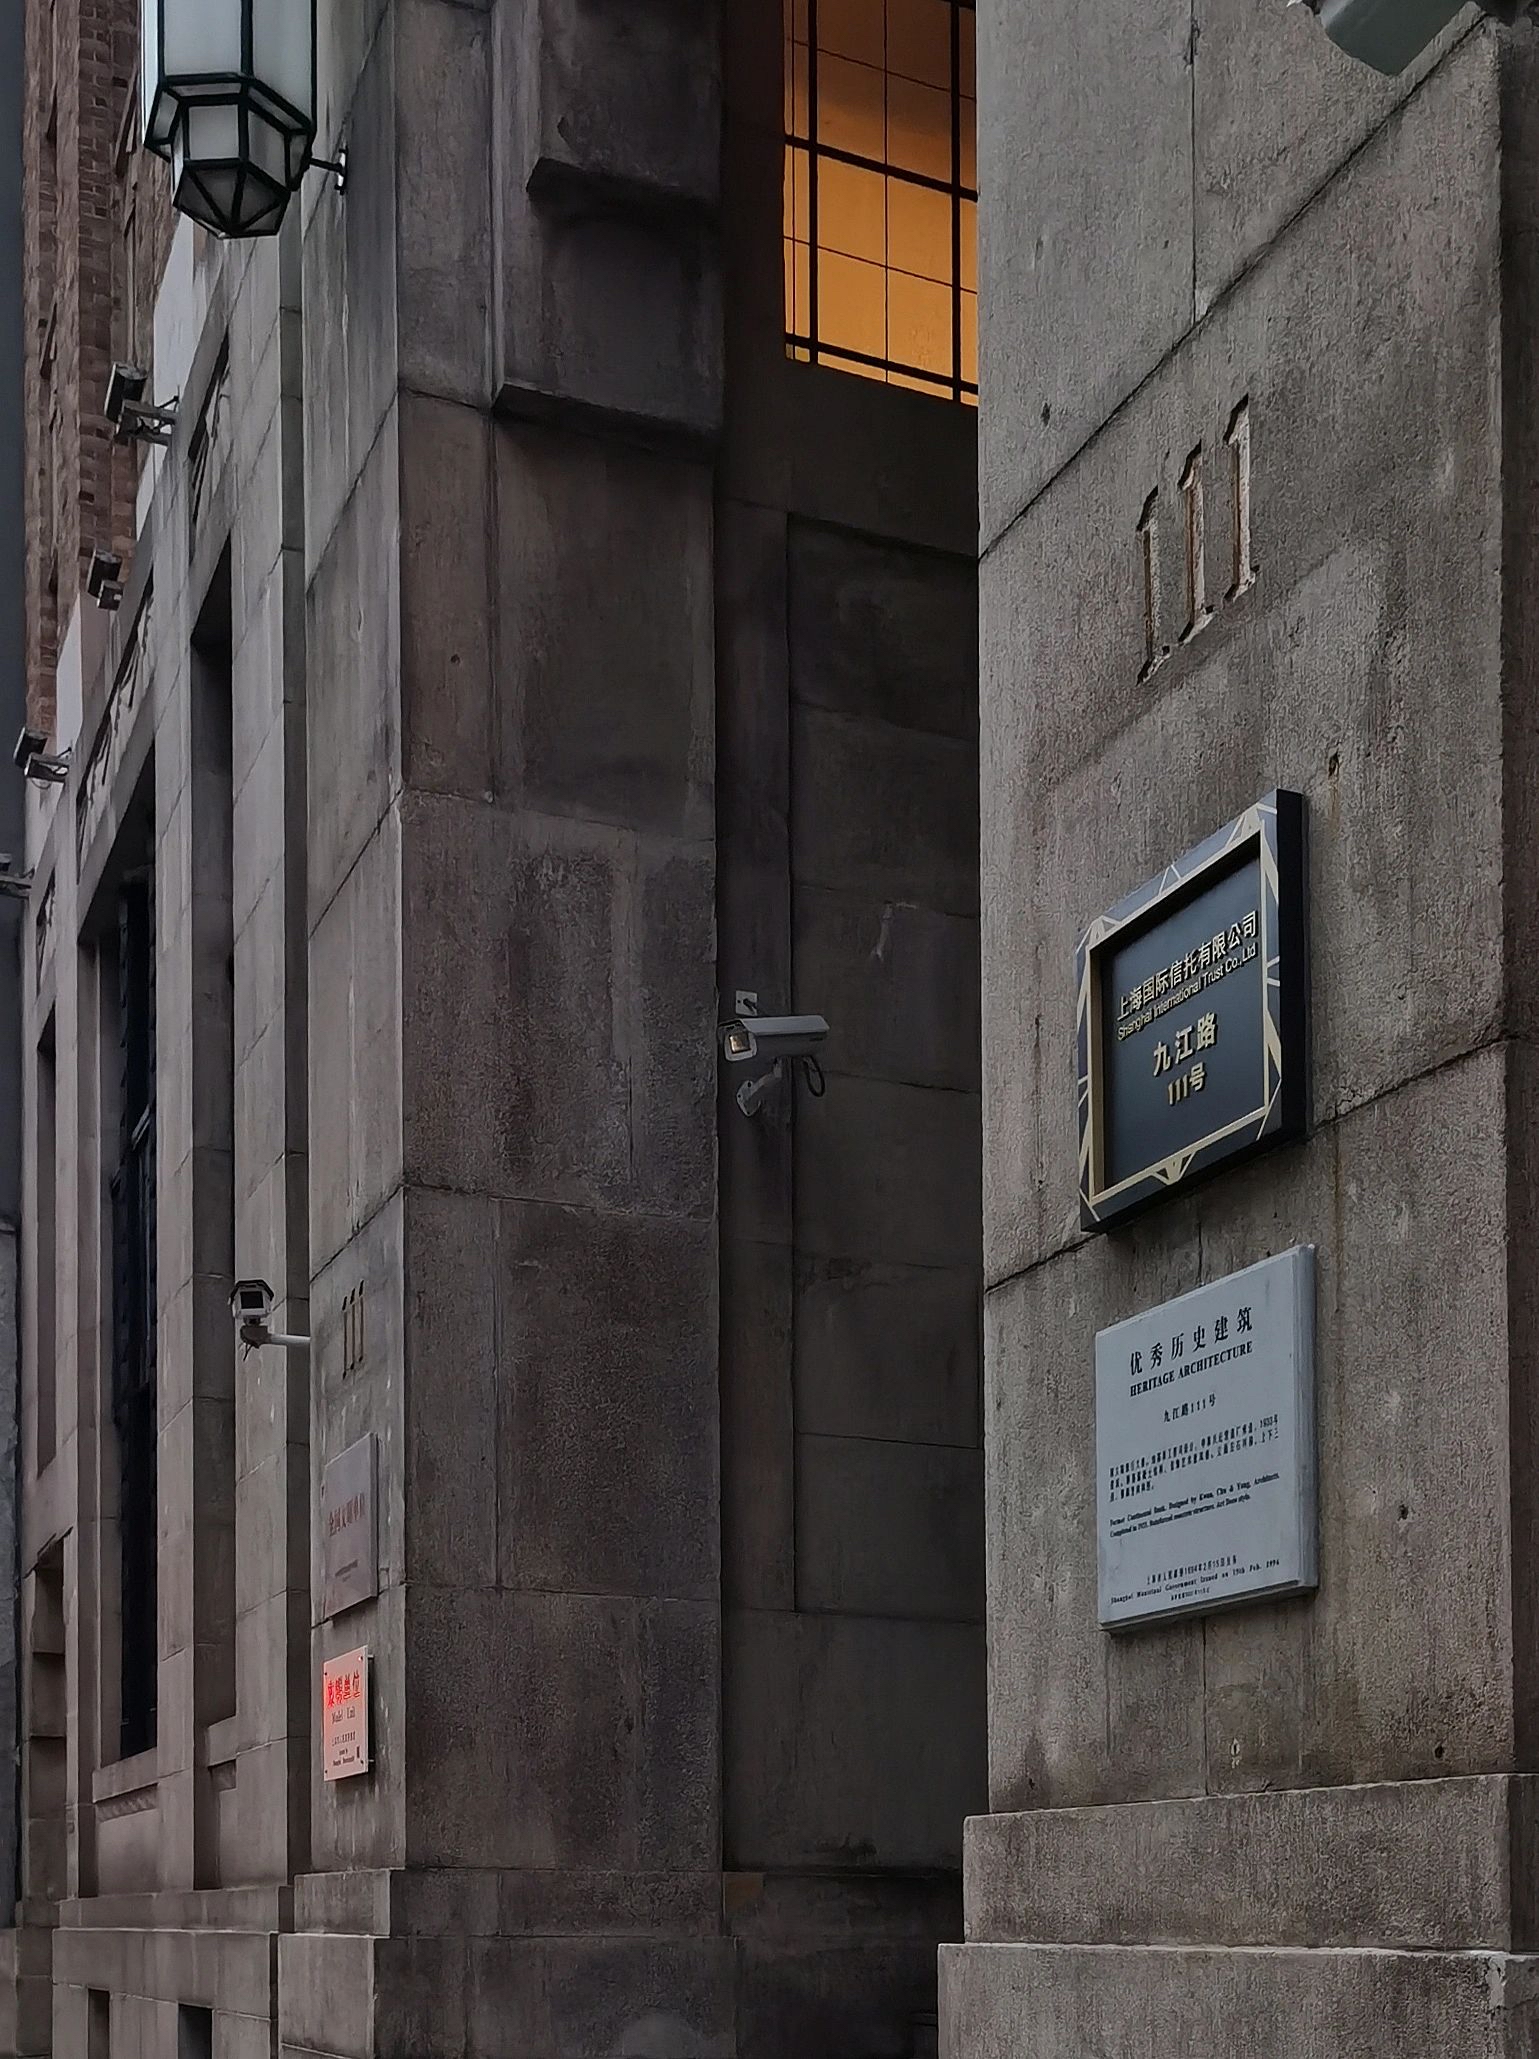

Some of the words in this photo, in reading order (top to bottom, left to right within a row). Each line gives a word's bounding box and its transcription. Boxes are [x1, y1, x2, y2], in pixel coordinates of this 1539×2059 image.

[1136, 393, 1260, 686] 111
[1117, 910, 1258, 1022] 上海国际信托有限公司
[1118, 1008, 1152, 1040] Shanghai
[1153, 977, 1201, 1019] International
[1203, 964, 1225, 988] Trust
[1153, 1012, 1217, 1077] 九江路
[1168, 1061, 1207, 1105] 111号
[1130, 1307, 1253, 1376] 优秀历史建筑
[1130, 1370, 1175, 1397] HERITAGE
[1178, 1341, 1253, 1379] ARCHITECTURE
[1163, 1393, 1216, 1423] 九江路111号
